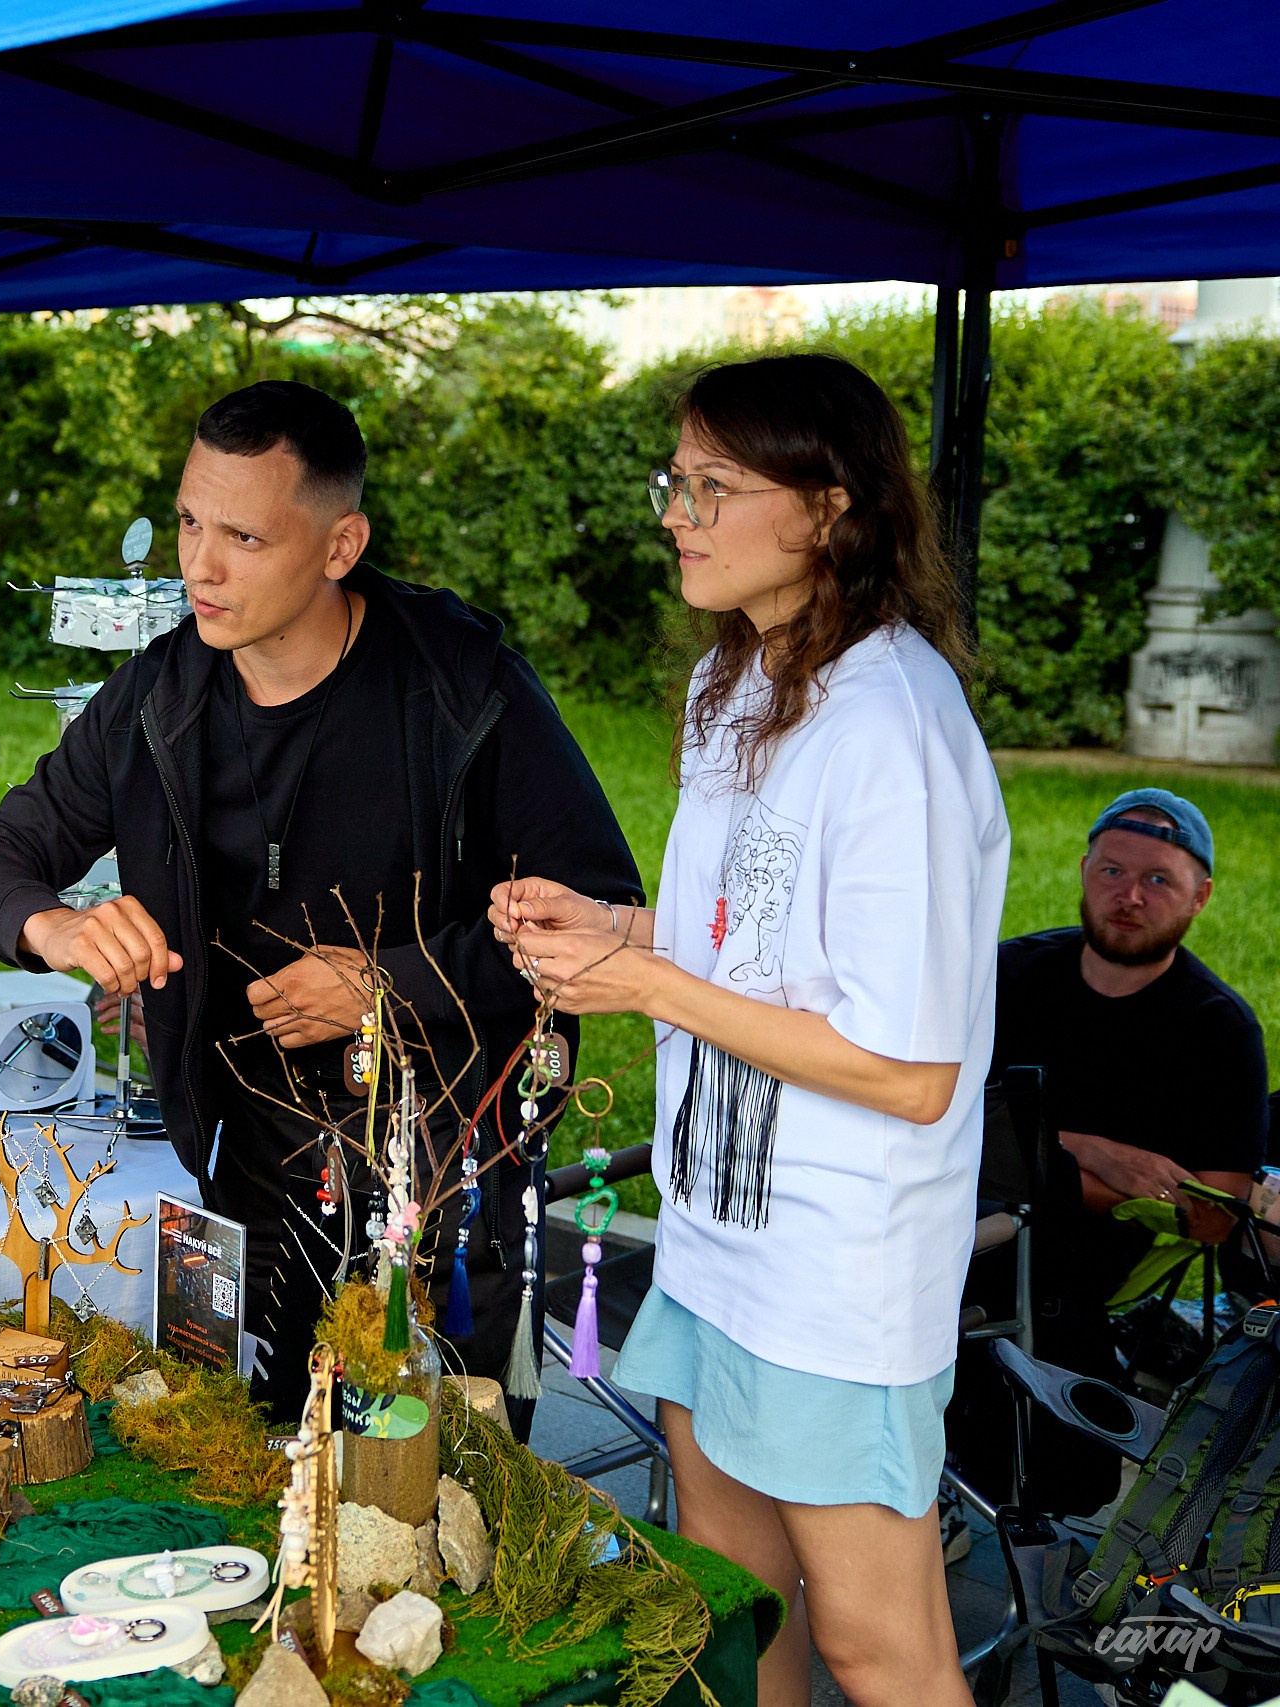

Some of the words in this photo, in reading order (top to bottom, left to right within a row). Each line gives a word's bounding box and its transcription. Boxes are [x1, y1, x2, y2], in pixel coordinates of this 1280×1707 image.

[182, 1233, 207, 1253] НАКУЙ
[207, 1243, 222, 1259] ВСЁ
[18, 1355, 50, 1364] 250
[38, 1593, 59, 1613] 1200
